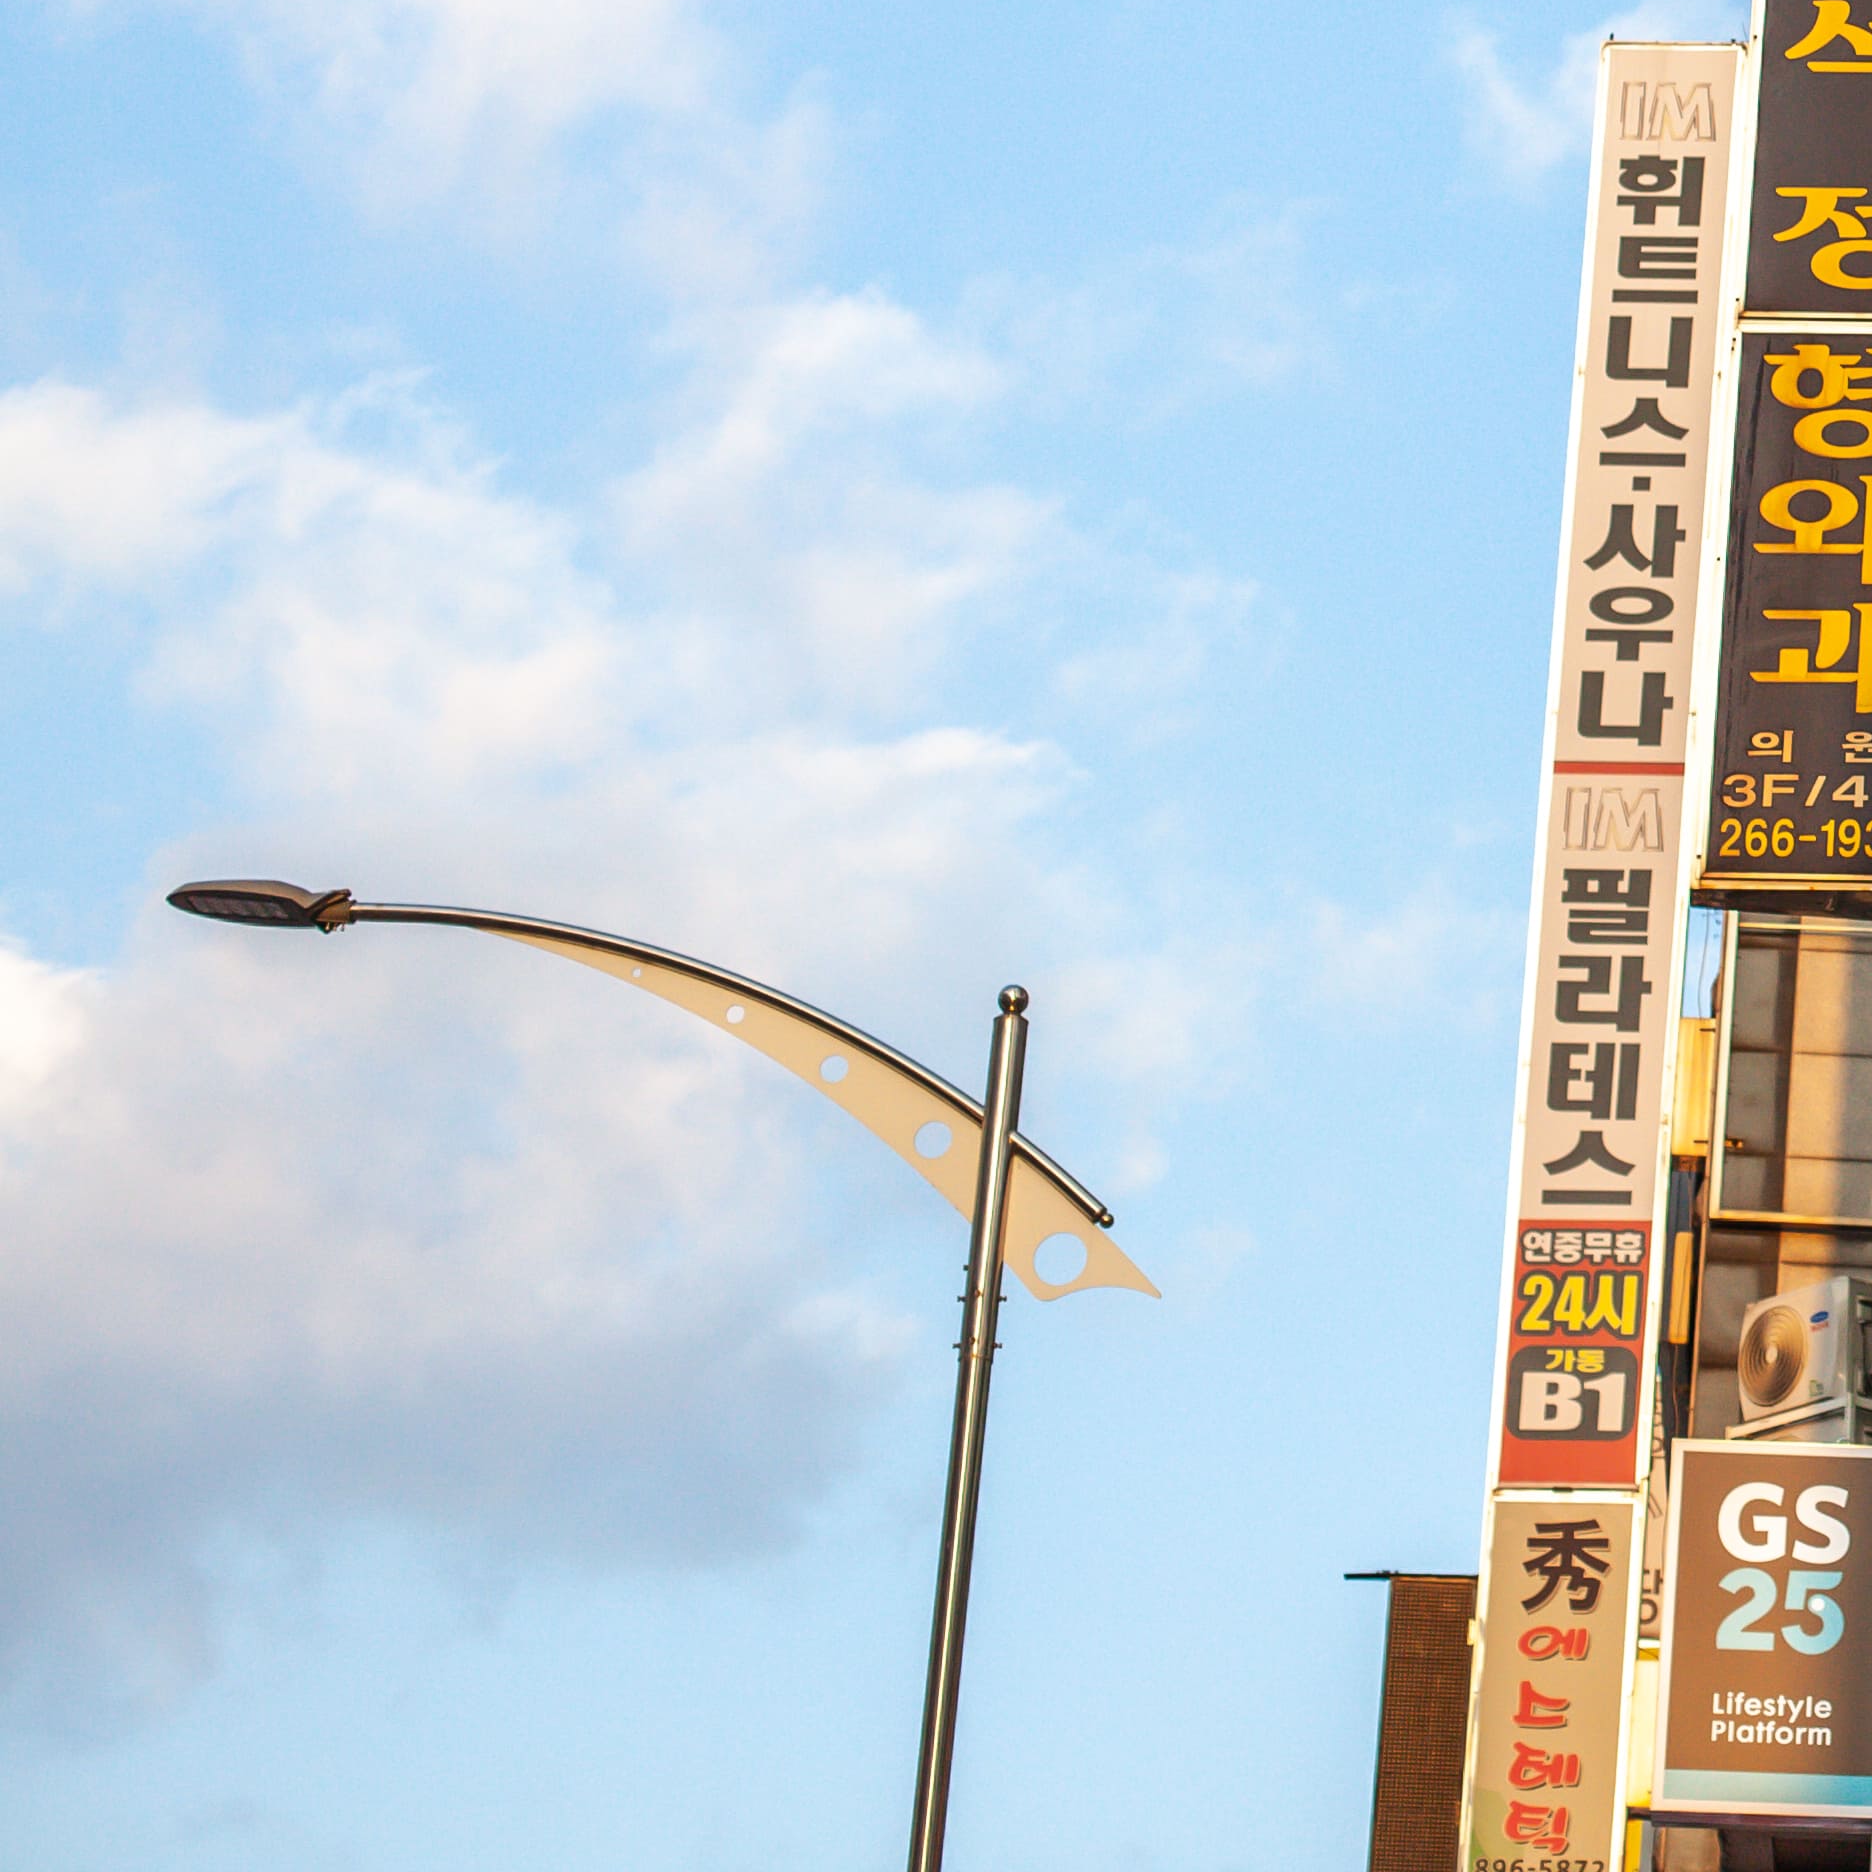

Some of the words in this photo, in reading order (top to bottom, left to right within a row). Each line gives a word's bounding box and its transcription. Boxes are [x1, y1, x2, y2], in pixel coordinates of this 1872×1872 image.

[1618, 80, 1717, 142] IM
[1561, 786, 1665, 853] IM
[1541, 867, 1654, 1206] 필라테스
[1521, 1230, 1643, 1264] 연중무휴
[1520, 1274, 1639, 1336] 24시
[1544, 1349, 1606, 1374] 가동
[1518, 1371, 1627, 1432] B1
[1716, 1480, 1851, 1566] GS
[1521, 1518, 1612, 1615] 秀
[1715, 1567, 1846, 1656] 25
[1710, 1719, 1833, 1747] Platform
[1711, 1691, 1833, 1722] Lifestyle
[1502, 1624, 1590, 1857] 에스테틱
